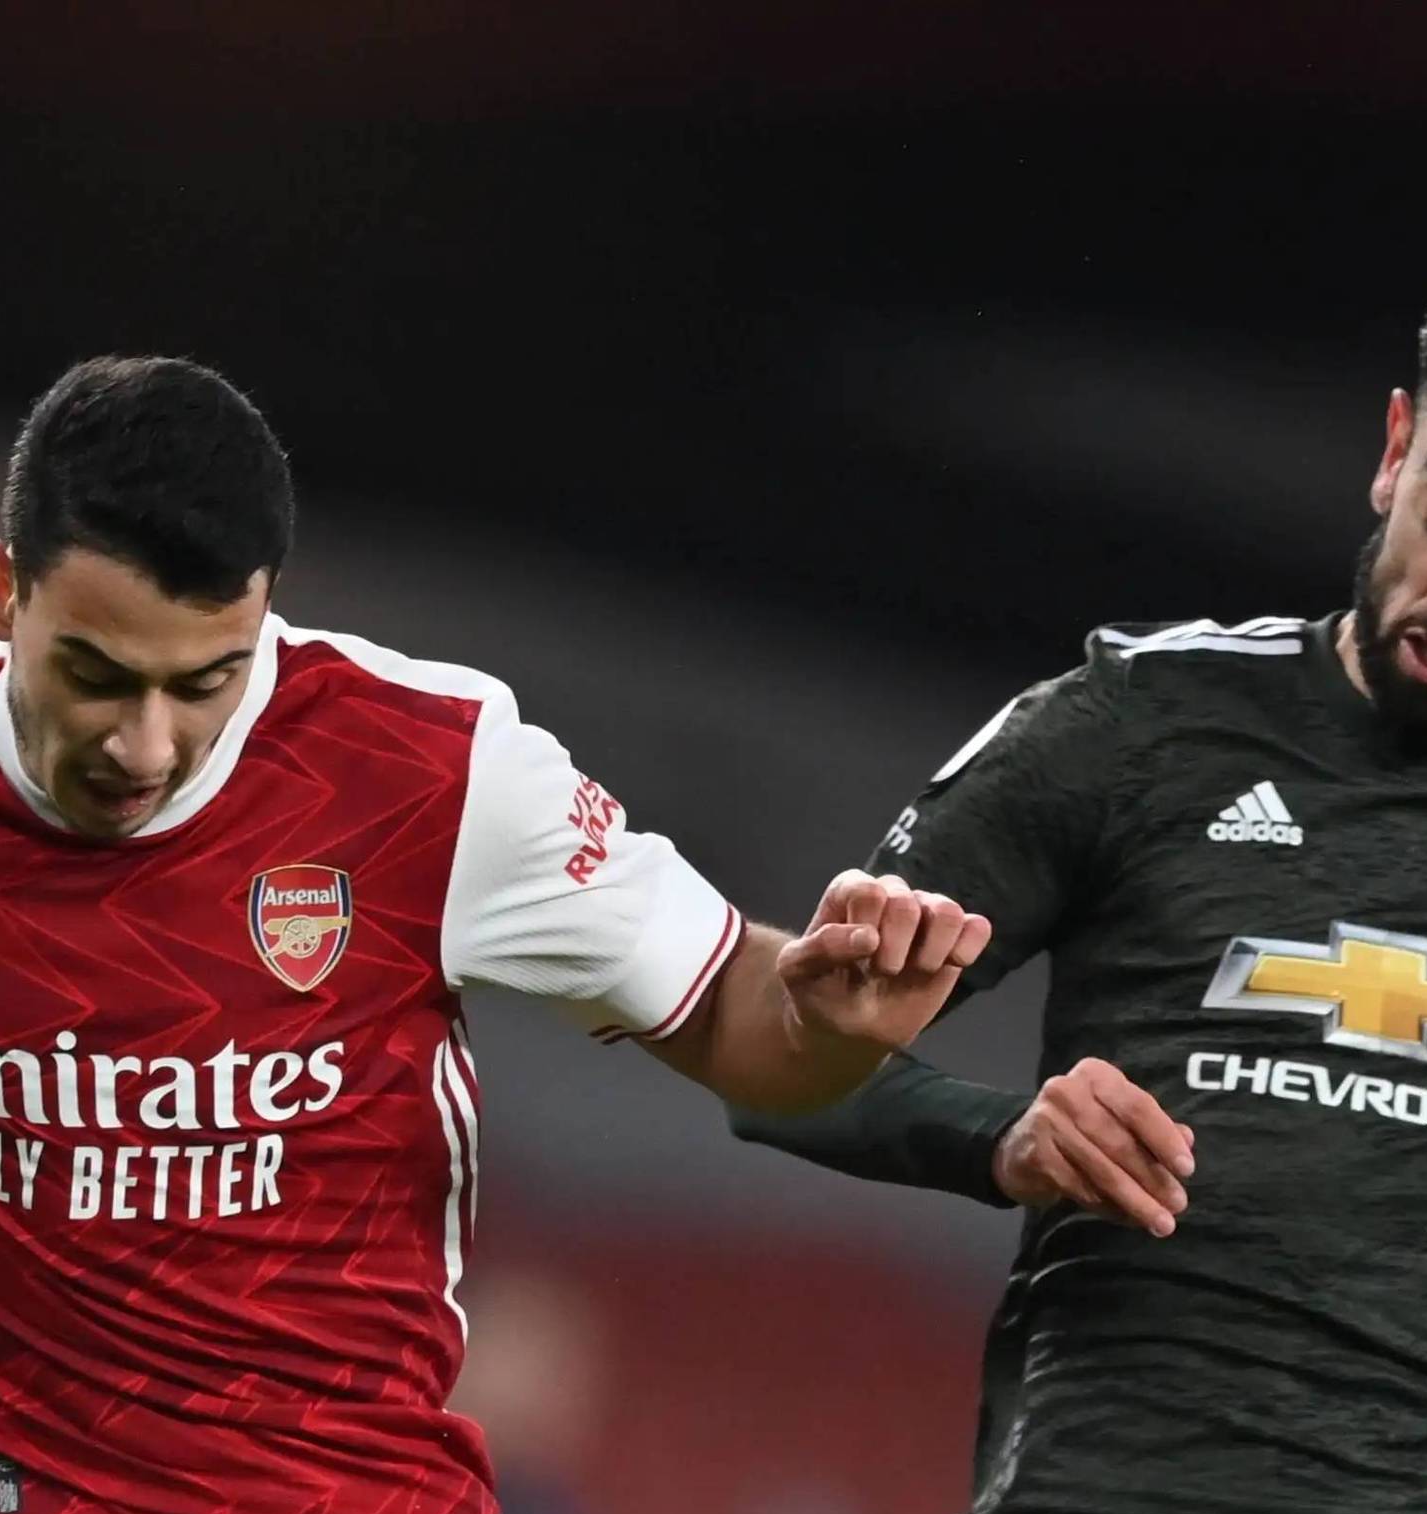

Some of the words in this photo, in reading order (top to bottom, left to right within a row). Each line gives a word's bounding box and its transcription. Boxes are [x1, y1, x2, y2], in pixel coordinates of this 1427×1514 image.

[1206, 820, 1304, 846] adidas
[262, 884, 338, 907] Arsenal
[68, 1133, 283, 1220] BETTER
